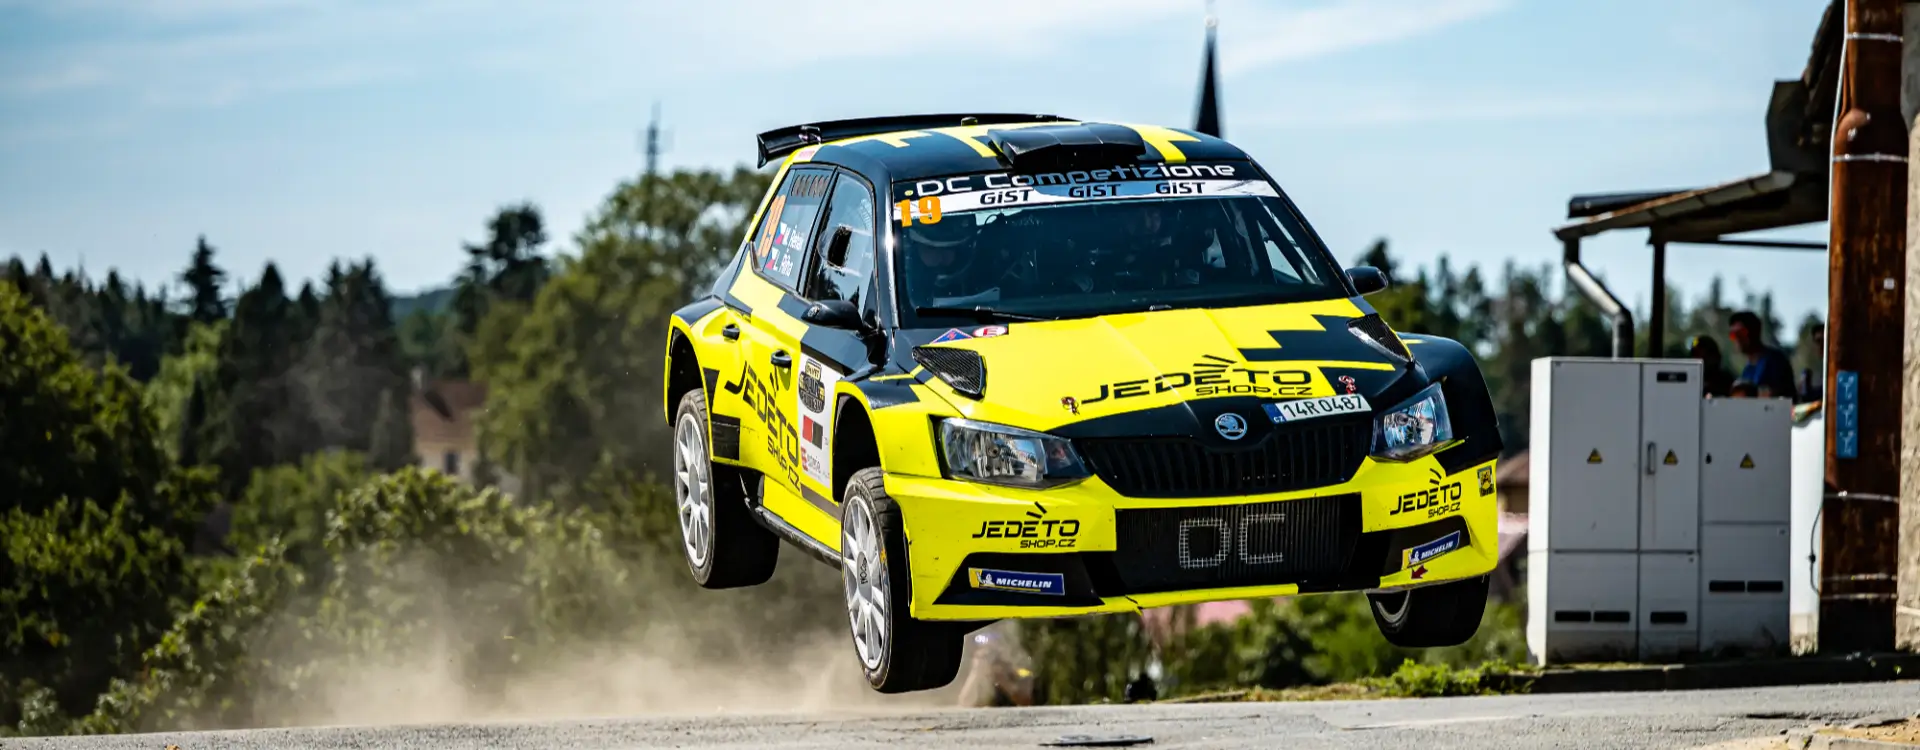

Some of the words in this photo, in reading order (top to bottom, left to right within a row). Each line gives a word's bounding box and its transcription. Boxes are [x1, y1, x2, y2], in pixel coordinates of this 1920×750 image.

[916, 175, 972, 196] DC
[984, 162, 1235, 187] Competizione
[896, 196, 942, 227] 19
[1081, 370, 1313, 404] JEDETO
[1196, 385, 1313, 396] SHOP.CZ
[724, 361, 799, 467] JEDETO
[1273, 415, 1285, 423] CZ
[1390, 481, 1461, 516] JEDETO
[1427, 501, 1461, 518] SHOP.CZ
[972, 519, 1080, 539] JEDETO
[1019, 538, 1076, 549] SHOP.CZ
[1179, 513, 1286, 569] DC
[1420, 540, 1454, 560] MICHELIN
[995, 576, 1052, 589] MICHELIN
